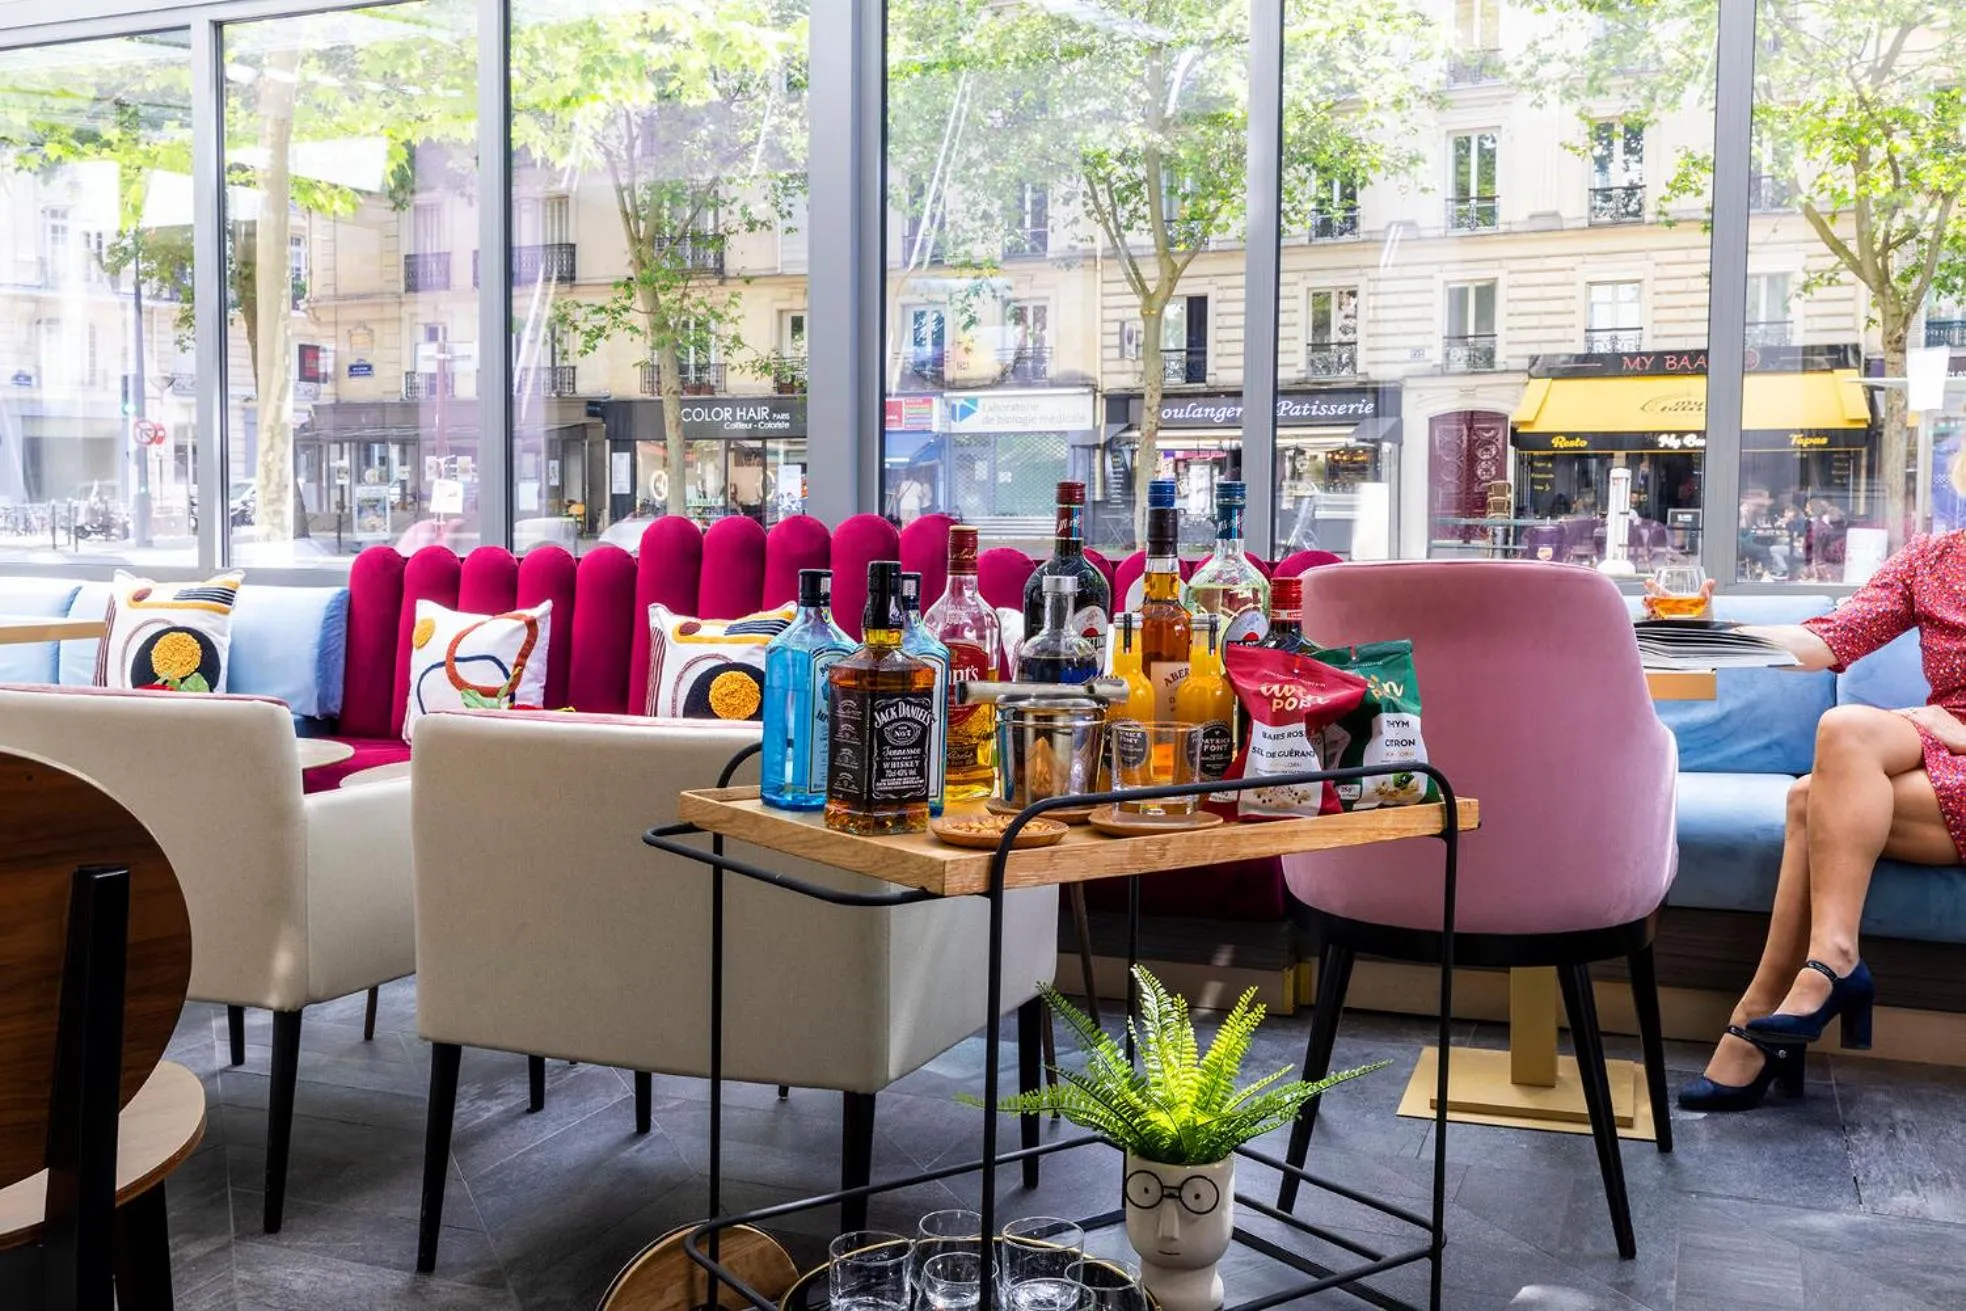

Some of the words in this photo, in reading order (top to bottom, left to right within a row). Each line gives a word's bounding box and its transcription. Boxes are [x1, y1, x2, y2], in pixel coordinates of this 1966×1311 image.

[1622, 356, 1655, 371] MY
[1664, 355, 1707, 370] BAA
[982, 400, 1039, 412] Laboratoire
[1161, 402, 1244, 423] oulanger
[1276, 398, 1374, 416] Patisserie
[681, 407, 732, 422] COLOR
[736, 406, 770, 421] HAIR
[723, 421, 753, 430] Coiffeur
[758, 421, 790, 430] Coloriste
[1551, 435, 1588, 448] Resto
[1788, 433, 1829, 448] Tapas
[1163, 667, 1190, 687] ABER
[874, 706, 898, 729] JACK
[1286, 730, 1304, 738] ROS
[882, 760, 921, 769] WHISKEY
